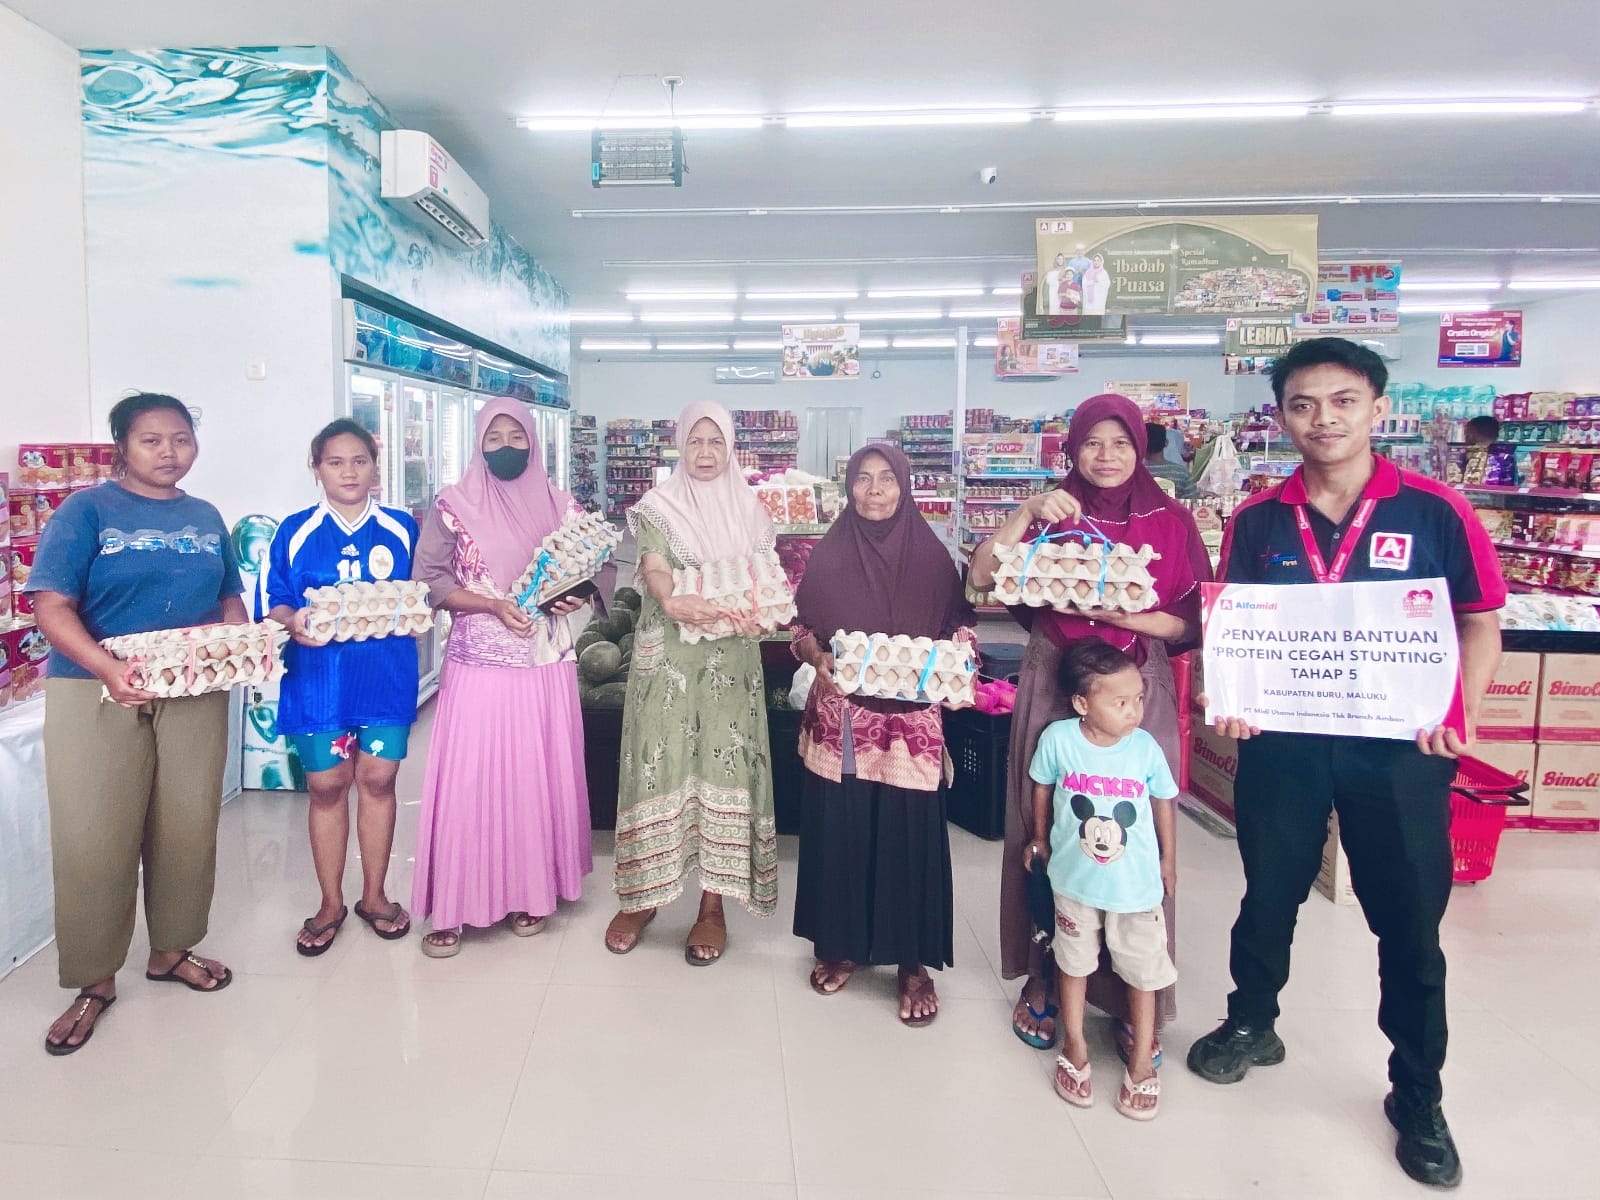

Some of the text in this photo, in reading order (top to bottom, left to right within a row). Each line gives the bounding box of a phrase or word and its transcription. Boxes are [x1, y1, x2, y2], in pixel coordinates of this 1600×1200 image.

[1112, 258, 1166, 273] Ibadah
[1112, 276, 1165, 293] Puasa
[1447, 329, 1470, 337] Gratis
[337, 559, 362, 580] 11
[1235, 602, 1278, 610] Alfamidi
[1222, 629, 1438, 643] PENYALURAN BANTUAN
[1288, 649, 1344, 662] CEGAH
[1290, 668, 1358, 681] TAHAP 5
[1263, 689, 1387, 701] KABUPATEN BURU, MALUKU
[1485, 679, 1600, 697] imoli Bimol
[1193, 737, 1238, 777] Bimoli
[1062, 770, 1145, 799] MICKEY
[1541, 770, 1600, 788] Bimoli
